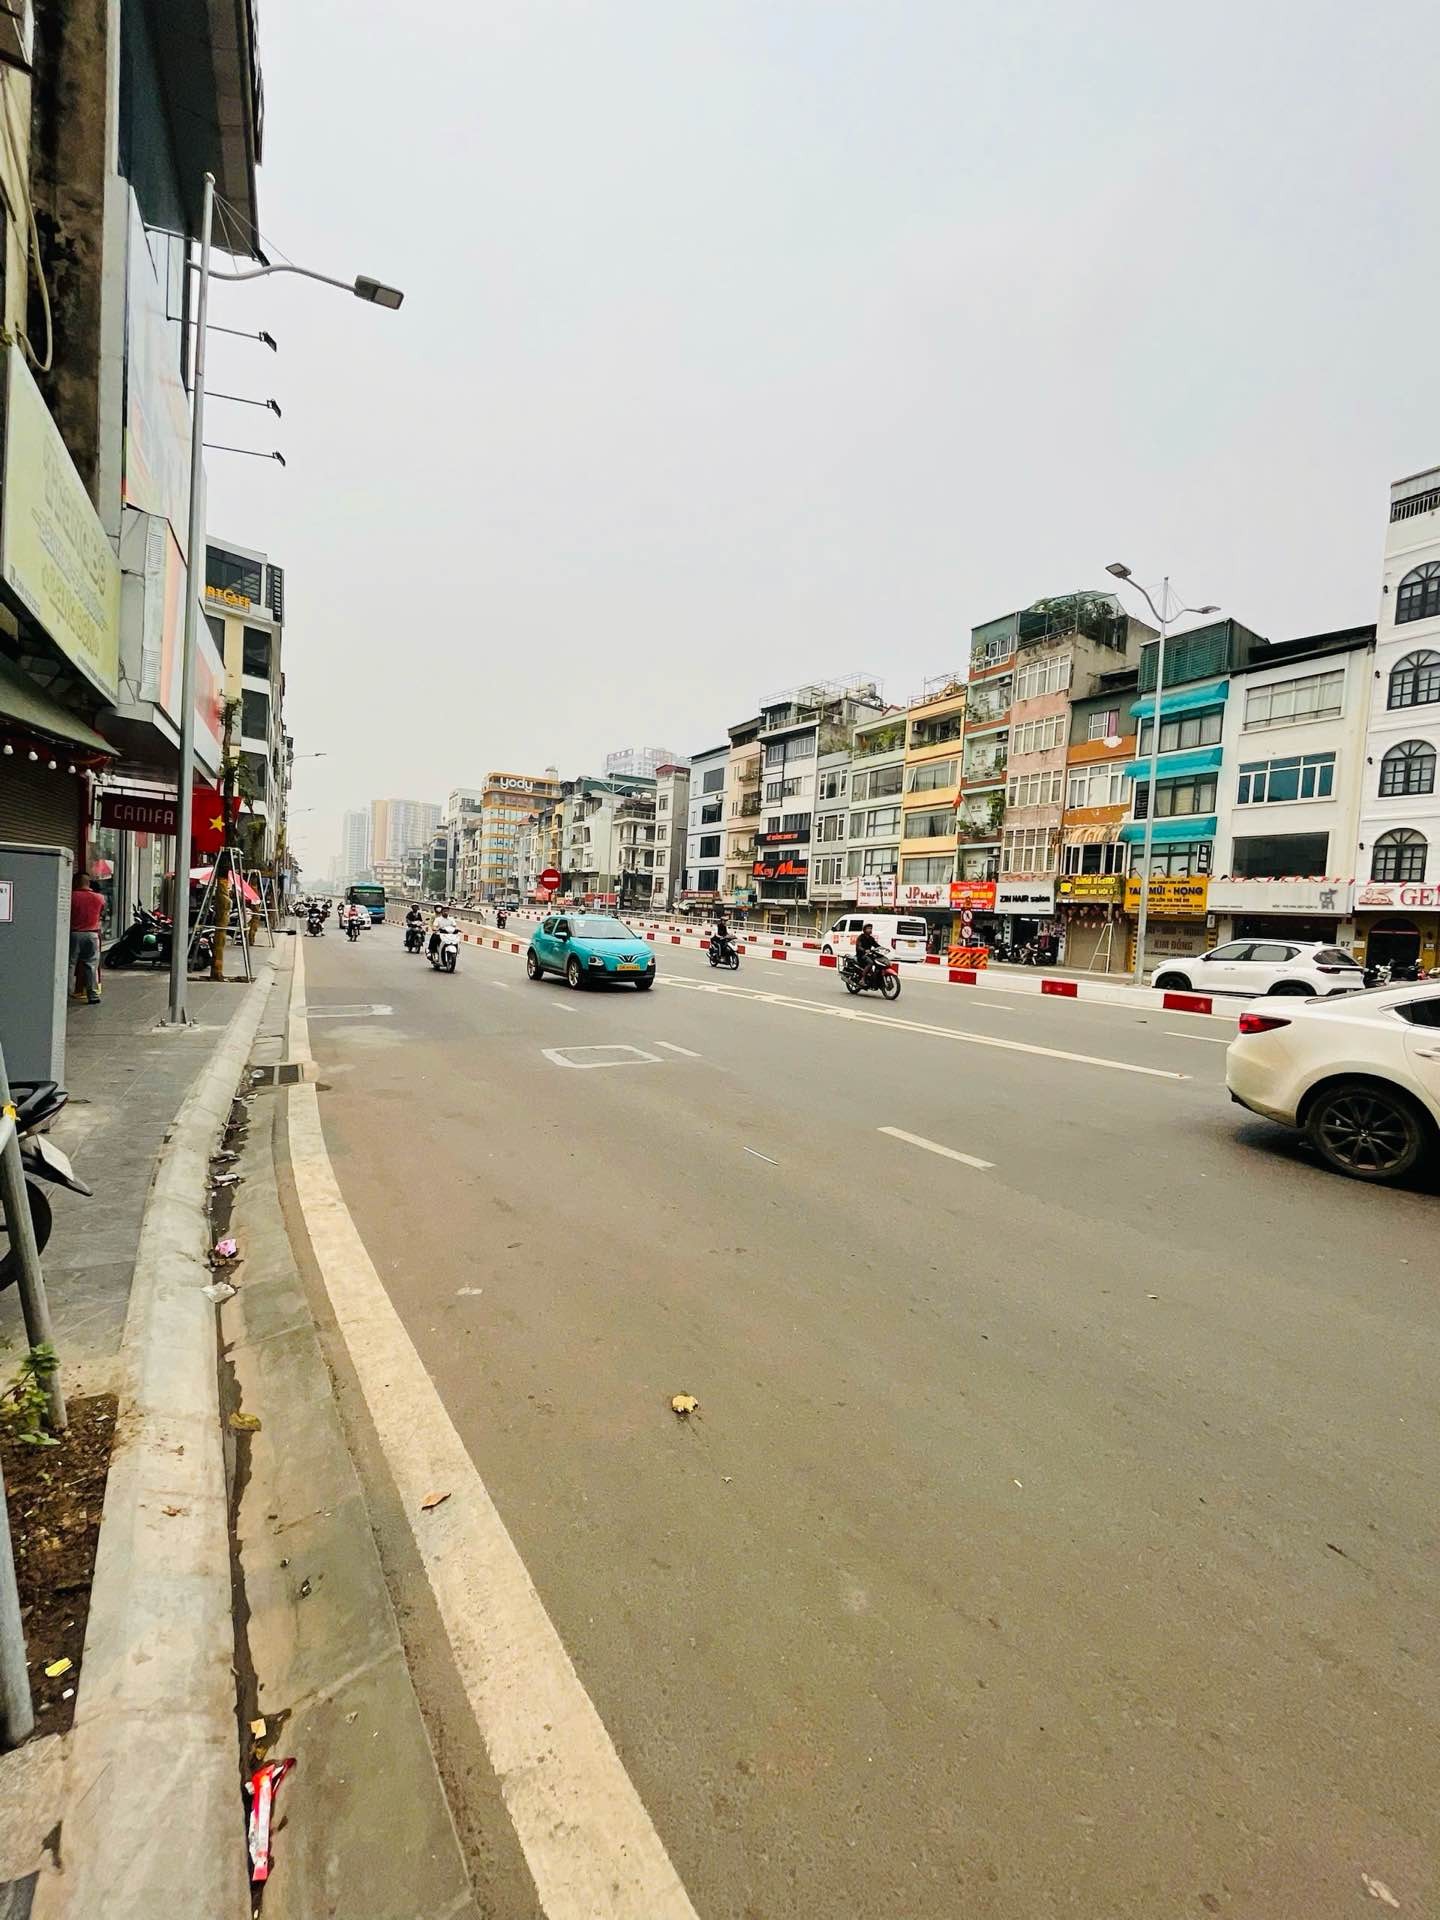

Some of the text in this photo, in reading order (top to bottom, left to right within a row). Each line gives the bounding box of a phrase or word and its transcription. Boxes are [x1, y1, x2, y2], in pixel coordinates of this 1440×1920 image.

[500, 776, 534, 793] yody
[113, 803, 174, 825] CANIFA
[1173, 886, 1203, 897] HỌNG
[1030, 895, 1050, 903] salon
